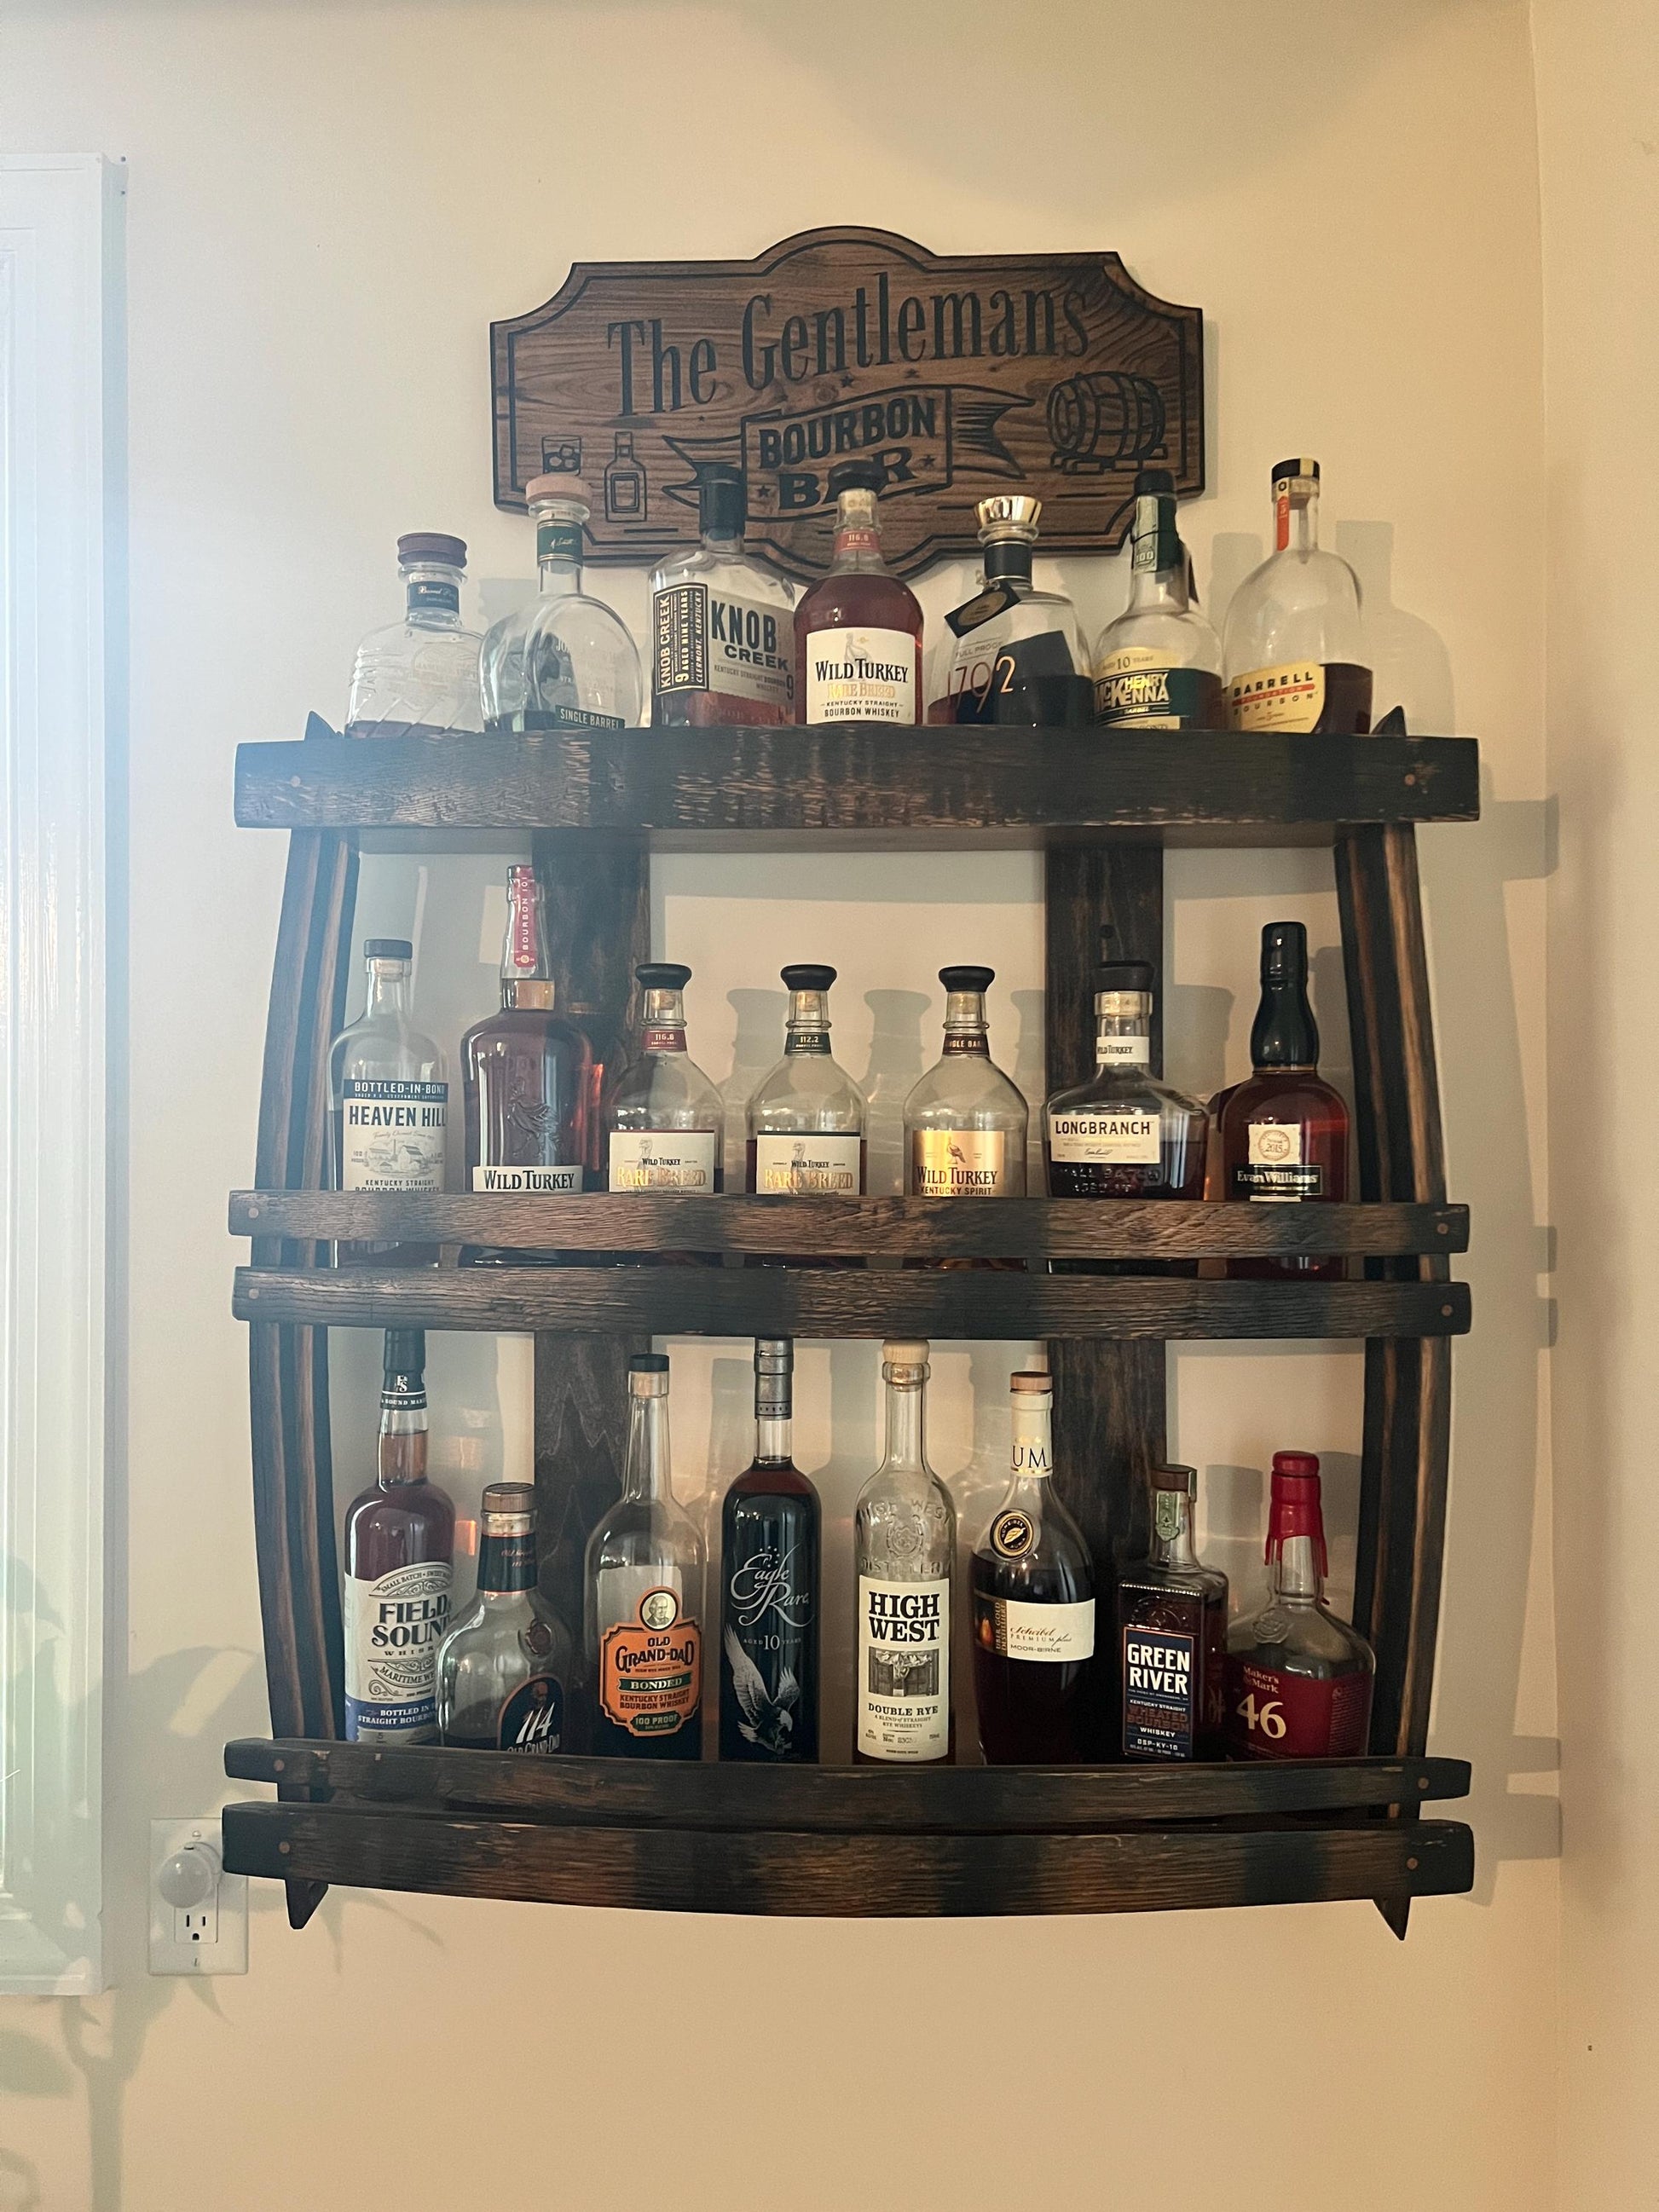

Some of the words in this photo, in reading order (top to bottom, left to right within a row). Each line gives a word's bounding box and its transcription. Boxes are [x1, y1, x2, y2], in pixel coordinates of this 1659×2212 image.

[606, 317, 718, 418] The
[741, 270, 1090, 394] Gentlemans
[757, 395, 938, 471] BOURBON
[659, 595, 670, 645] CREEK
[694, 591, 702, 635] KENTUCKY
[680, 622, 689, 644] NINE
[711, 600, 777, 654] KNOB
[660, 647, 671, 688] KNOB
[724, 644, 789, 672] CREEK
[1117, 656, 1130, 670] 10
[674, 673, 689, 683] 9
[815, 661, 853, 682] WILD
[854, 658, 909, 684] TURKEY
[786, 673, 795, 701] 9
[947, 656, 1016, 713] 1792
[1124, 673, 1169, 690] HENRY
[1233, 671, 1314, 698] BARRELL
[560, 708, 588, 725] SINGLE
[824, 707, 862, 718] BOURBON
[864, 707, 900, 718] WHISKEY
[520, 876, 529, 892] 101
[521, 898, 529, 950] BOURBON
[349, 1105, 417, 1127] HEAVEN
[421, 1107, 446, 1127] HILL
[1055, 1121, 1151, 1135] LONGBRANCH
[642, 1158, 658, 1166] WILD
[659, 1157, 681, 1166] TURKEY
[791, 1160, 807, 1169] WILD
[483, 1170, 523, 1190] WILD
[522, 1170, 575, 1191] TURKEY
[616, 1166, 655, 1187] RARE
[764, 1169, 803, 1191] RARE
[916, 1165, 947, 1184] WILD
[947, 1166, 998, 1187] TURKEY
[921, 1186, 962, 1195] KENTUCKY
[964, 1187, 992, 1196] SPIRIT
[731, 1542, 801, 1610] Eagle
[379, 1593, 448, 1624] FIELD
[738, 1581, 815, 1628] Rare
[868, 1591, 940, 1620] HIGH
[371, 1614, 450, 1648] SOUN
[868, 1615, 940, 1643] WEST
[1010, 1633, 1055, 1642] PREMIUM
[384, 1645, 434, 1656] WHISK
[647, 1637, 671, 1647] OLD
[743, 1637, 764, 1646] AGED
[764, 1634, 781, 1650] 10
[1010, 1643, 1062, 1654] MOOR-BIRNE
[615, 1640, 695, 1673] GRAND-DAD
[1127, 1643, 1190, 1672] GREEN
[379, 1666, 423, 1684] MARITIME
[630, 1678, 683, 1690] BONDED
[1129, 1666, 1188, 1695] RIVER
[1243, 1665, 1280, 1684] Maker's
[619, 1693, 658, 1702] KENTUCKY
[659, 1689, 691, 1701] STRAIGHT
[1251, 1677, 1279, 1694] Mark
[380, 1707, 419, 1717] BOTTLED
[619, 1701, 658, 1710] BOURBON
[660, 1696, 691, 1708] WHISKEY
[868, 1702, 913, 1717] DOUBLE
[916, 1705, 939, 1717] RYE
[1130, 1699, 1158, 1708] KENTUCKY
[1159, 1703, 1187, 1712] STRAIGHT
[357, 1715, 398, 1725] STRAIGHT
[515, 1701, 556, 1744] 114
[635, 1717, 650, 1725] 100
[652, 1714, 679, 1725] PROOF
[1126, 1713, 1189, 1733] BOURBON
[1128, 1706, 1188, 1722] WHEATED
[1236, 1692, 1287, 1739] 46
[1139, 1726, 1176, 1738] WHISKEY
